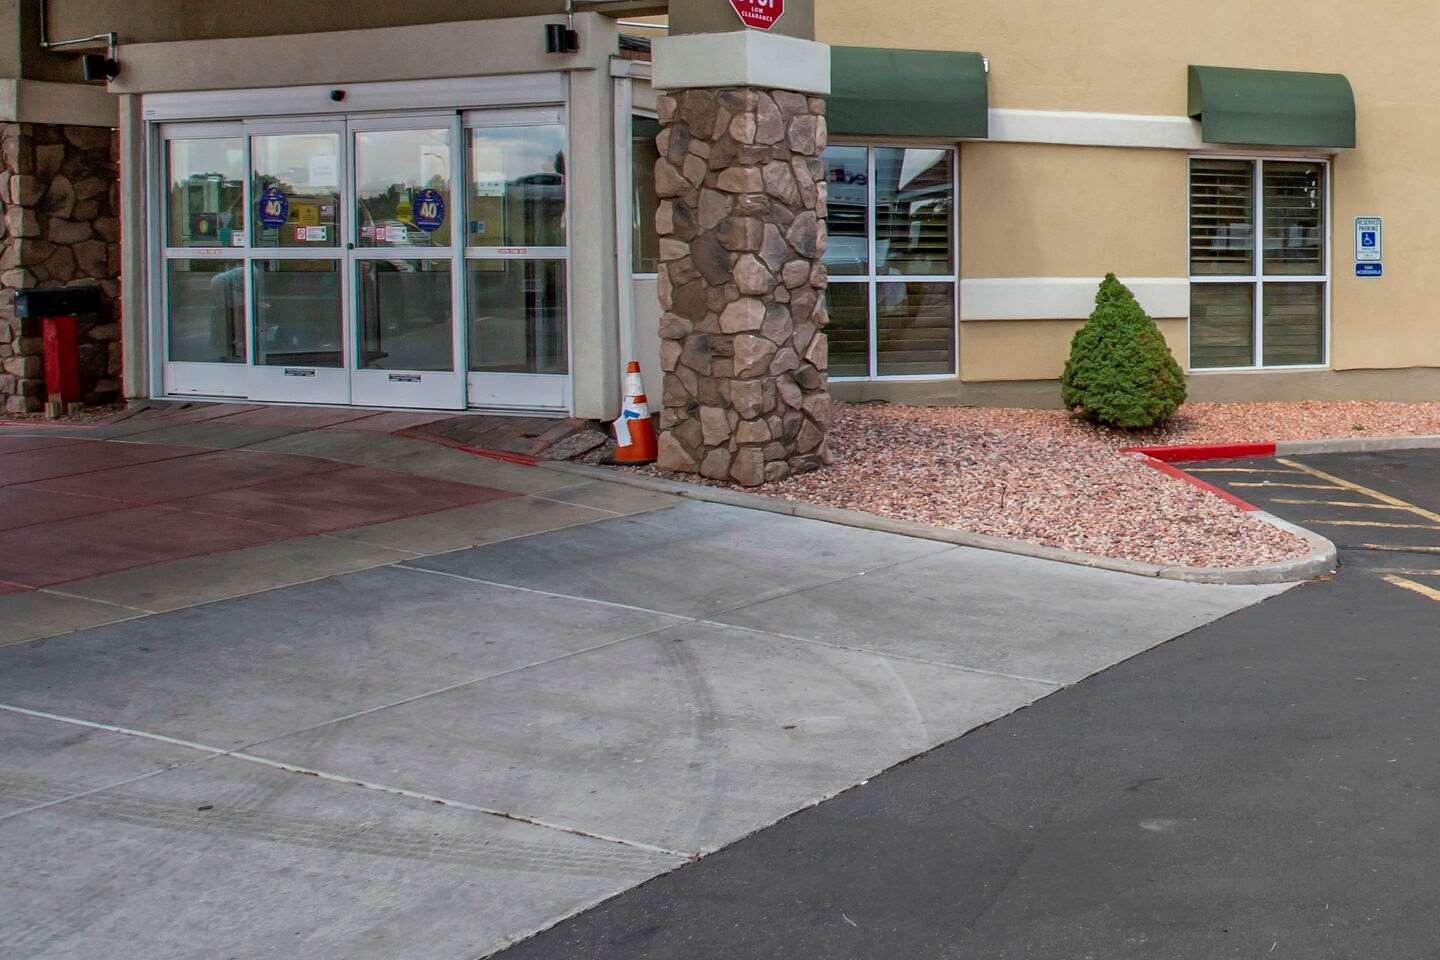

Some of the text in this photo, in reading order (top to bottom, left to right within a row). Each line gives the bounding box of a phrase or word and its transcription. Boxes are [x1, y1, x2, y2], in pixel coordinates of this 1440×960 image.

[741, 10, 773, 22] CLEARANCE
[751, 6, 764, 14] LOW
[265, 200, 281, 217] 40
[421, 201, 437, 220] 40
